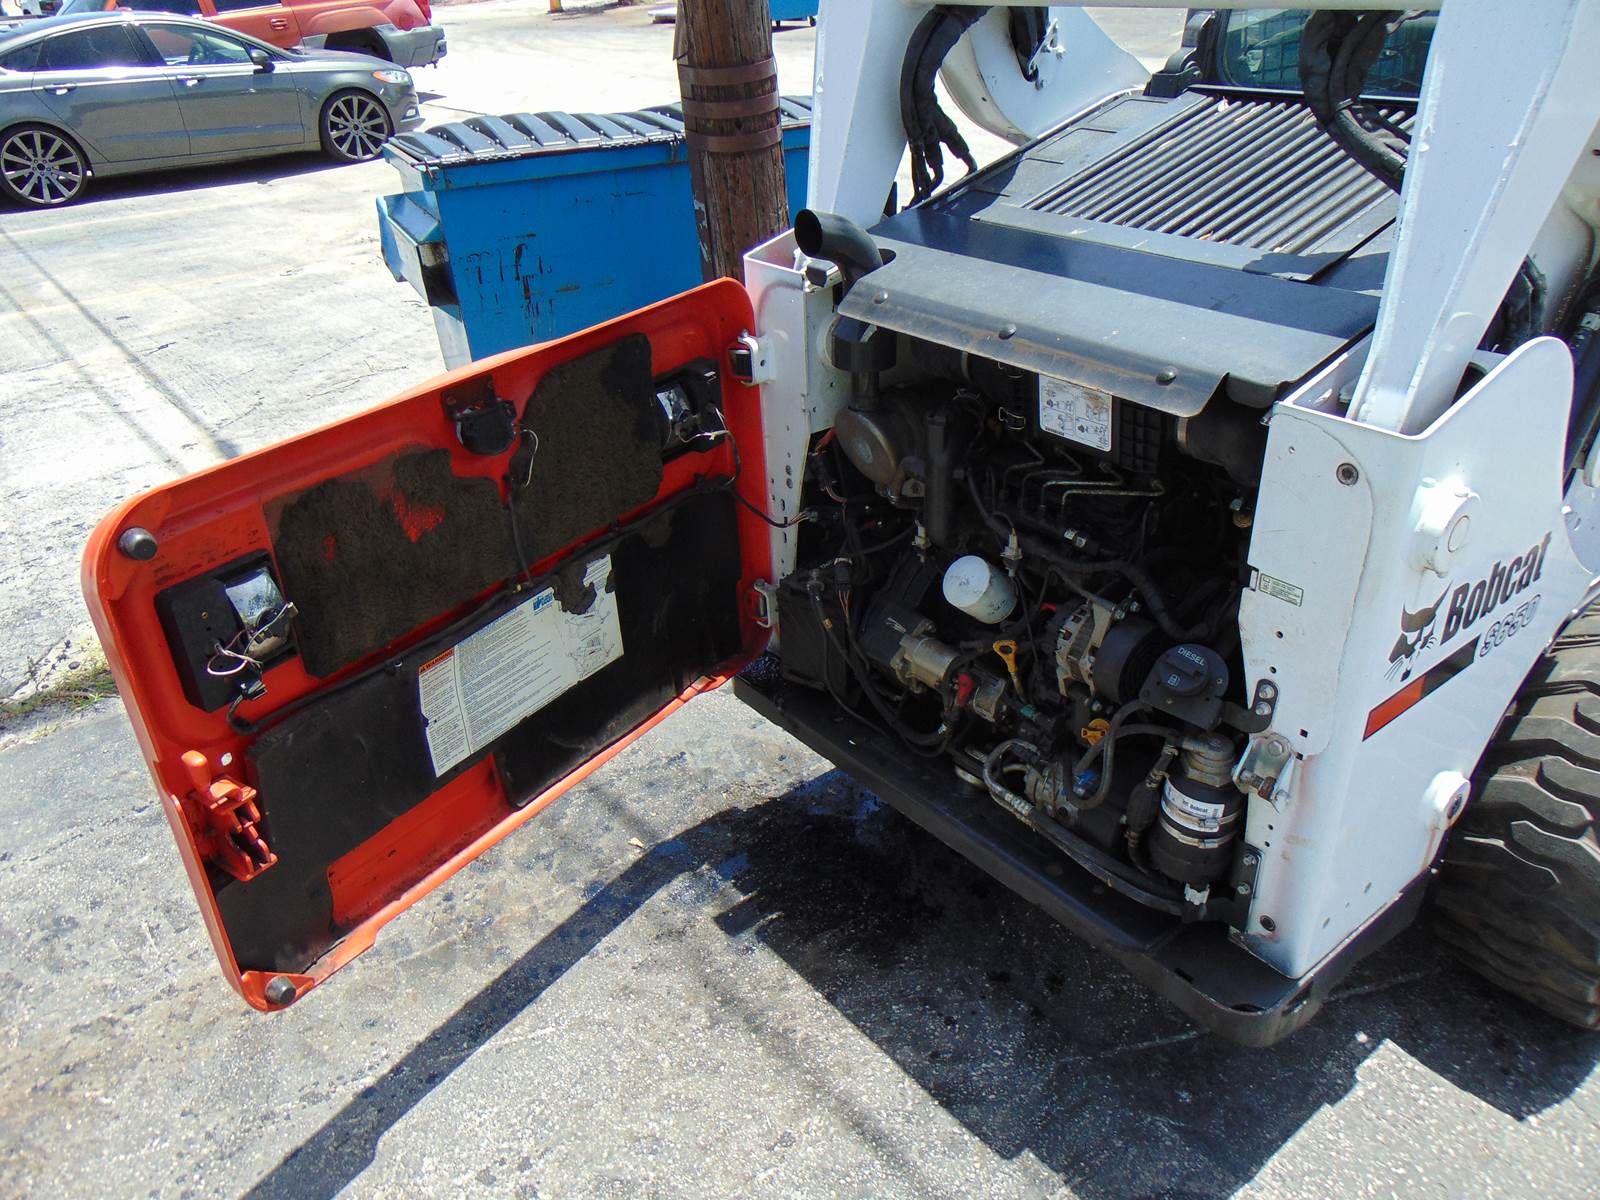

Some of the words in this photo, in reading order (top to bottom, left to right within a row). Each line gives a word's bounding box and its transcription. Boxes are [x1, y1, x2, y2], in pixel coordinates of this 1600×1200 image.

[1438, 530, 1553, 647] Bobcat
[1177, 647, 1205, 666] DIESEL
[1479, 594, 1541, 657] S650
